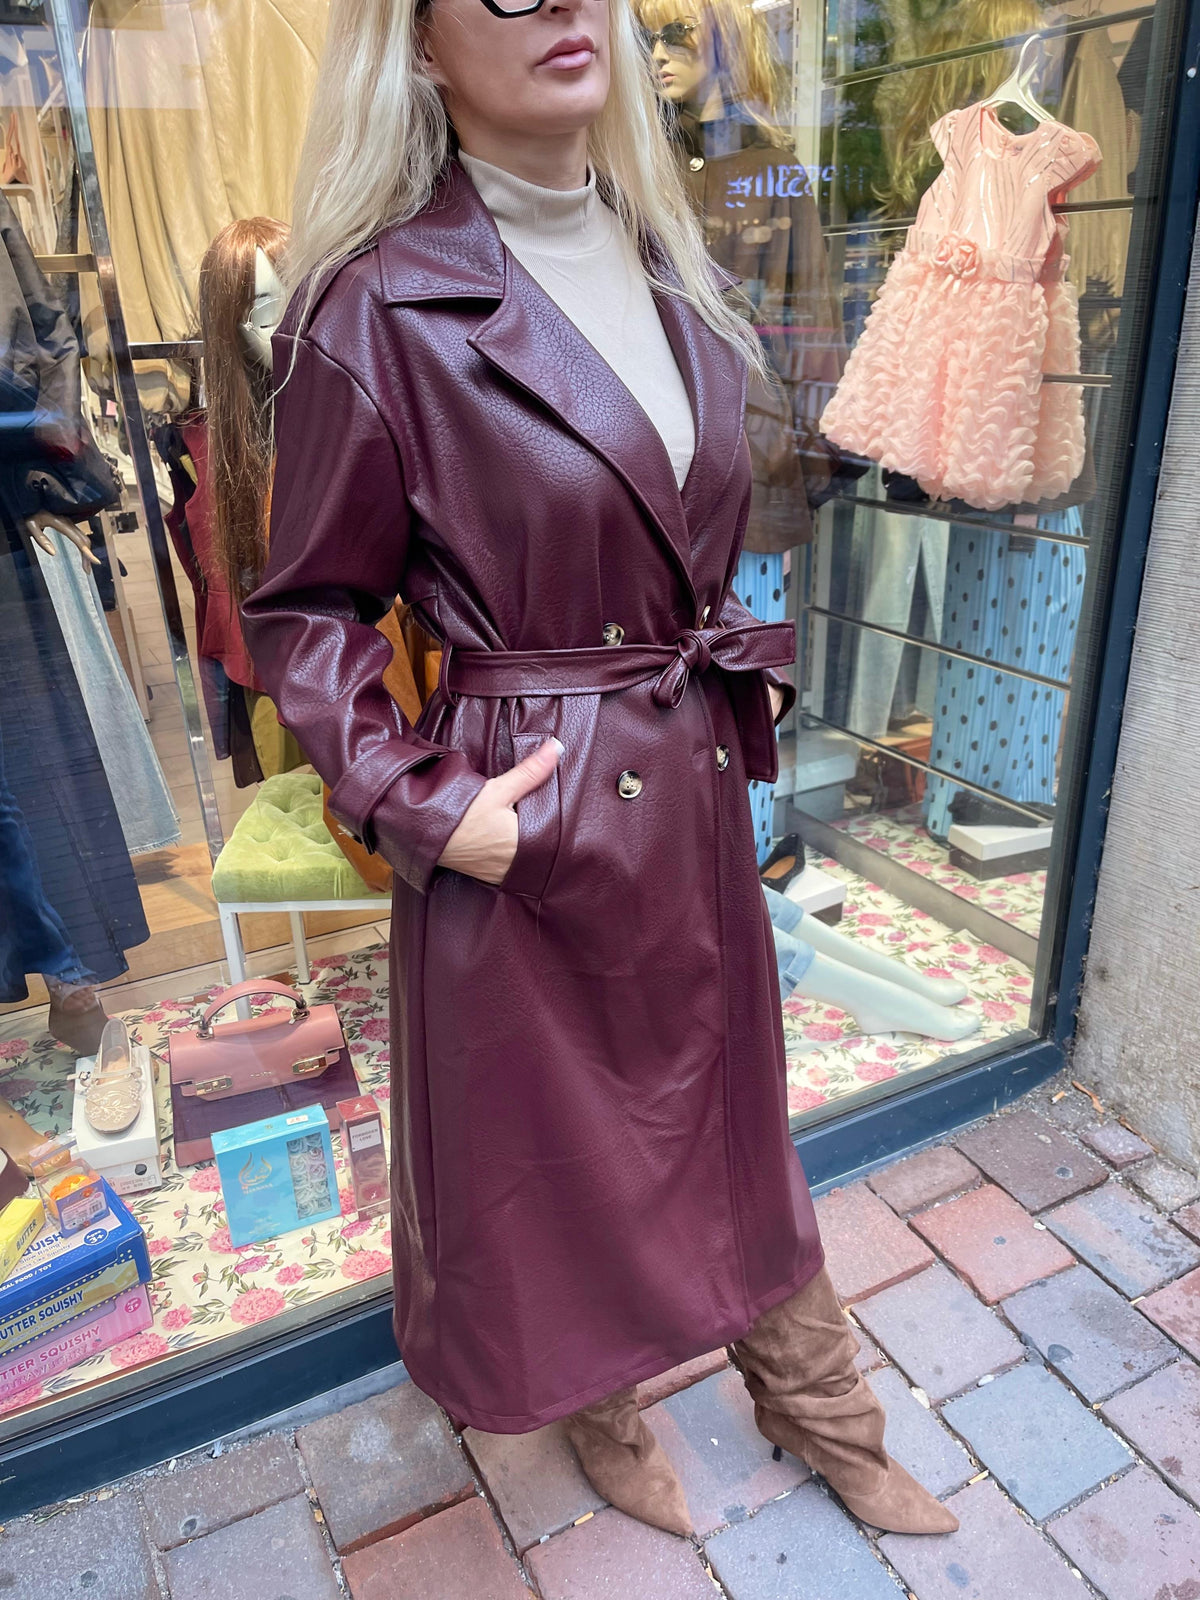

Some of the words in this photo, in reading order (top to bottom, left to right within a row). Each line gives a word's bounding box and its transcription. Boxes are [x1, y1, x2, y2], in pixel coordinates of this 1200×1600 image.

[16, 1218, 37, 1251] BUTTER
[22, 1231, 64, 1257] QUISH
[89, 1234, 104, 1244] 3+
[15, 1273, 34, 1285] FOOD
[38, 1263, 52, 1273] TOY
[0, 1315, 36, 1339] UTTER
[38, 1290, 84, 1321] SQUISHY
[0, 1358, 35, 1380] TTER
[40, 1326, 99, 1361] SQUISHY
[1, 1343, 88, 1392] STRAWBERRY
